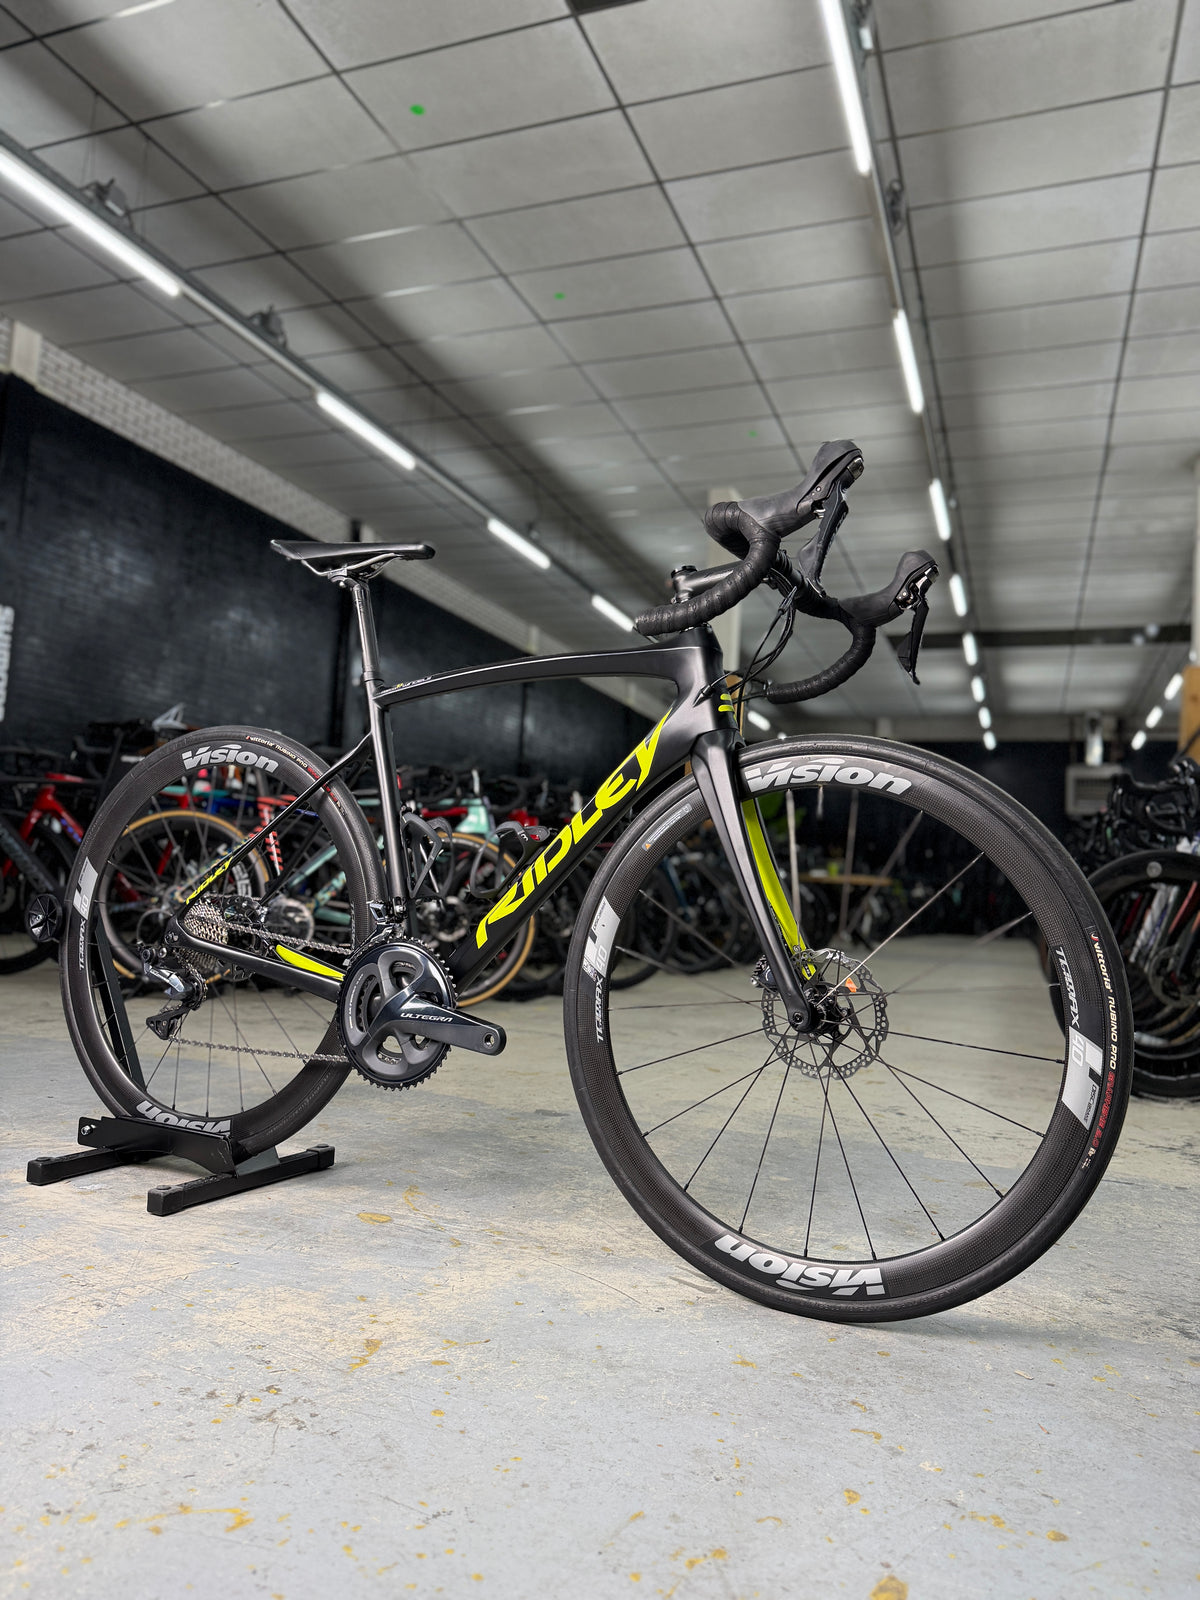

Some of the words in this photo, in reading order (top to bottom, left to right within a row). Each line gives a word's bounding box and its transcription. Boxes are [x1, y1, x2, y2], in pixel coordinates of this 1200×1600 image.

[182, 744, 279, 774] Vision
[744, 757, 912, 795] Vision
[476, 708, 672, 949] RIDLEY
[400, 1012, 453, 1023] ULTEGRA
[1107, 996, 1118, 1043] RUBINO
[1109, 1044, 1118, 1070] PRO
[714, 1234, 886, 1296] Vision
